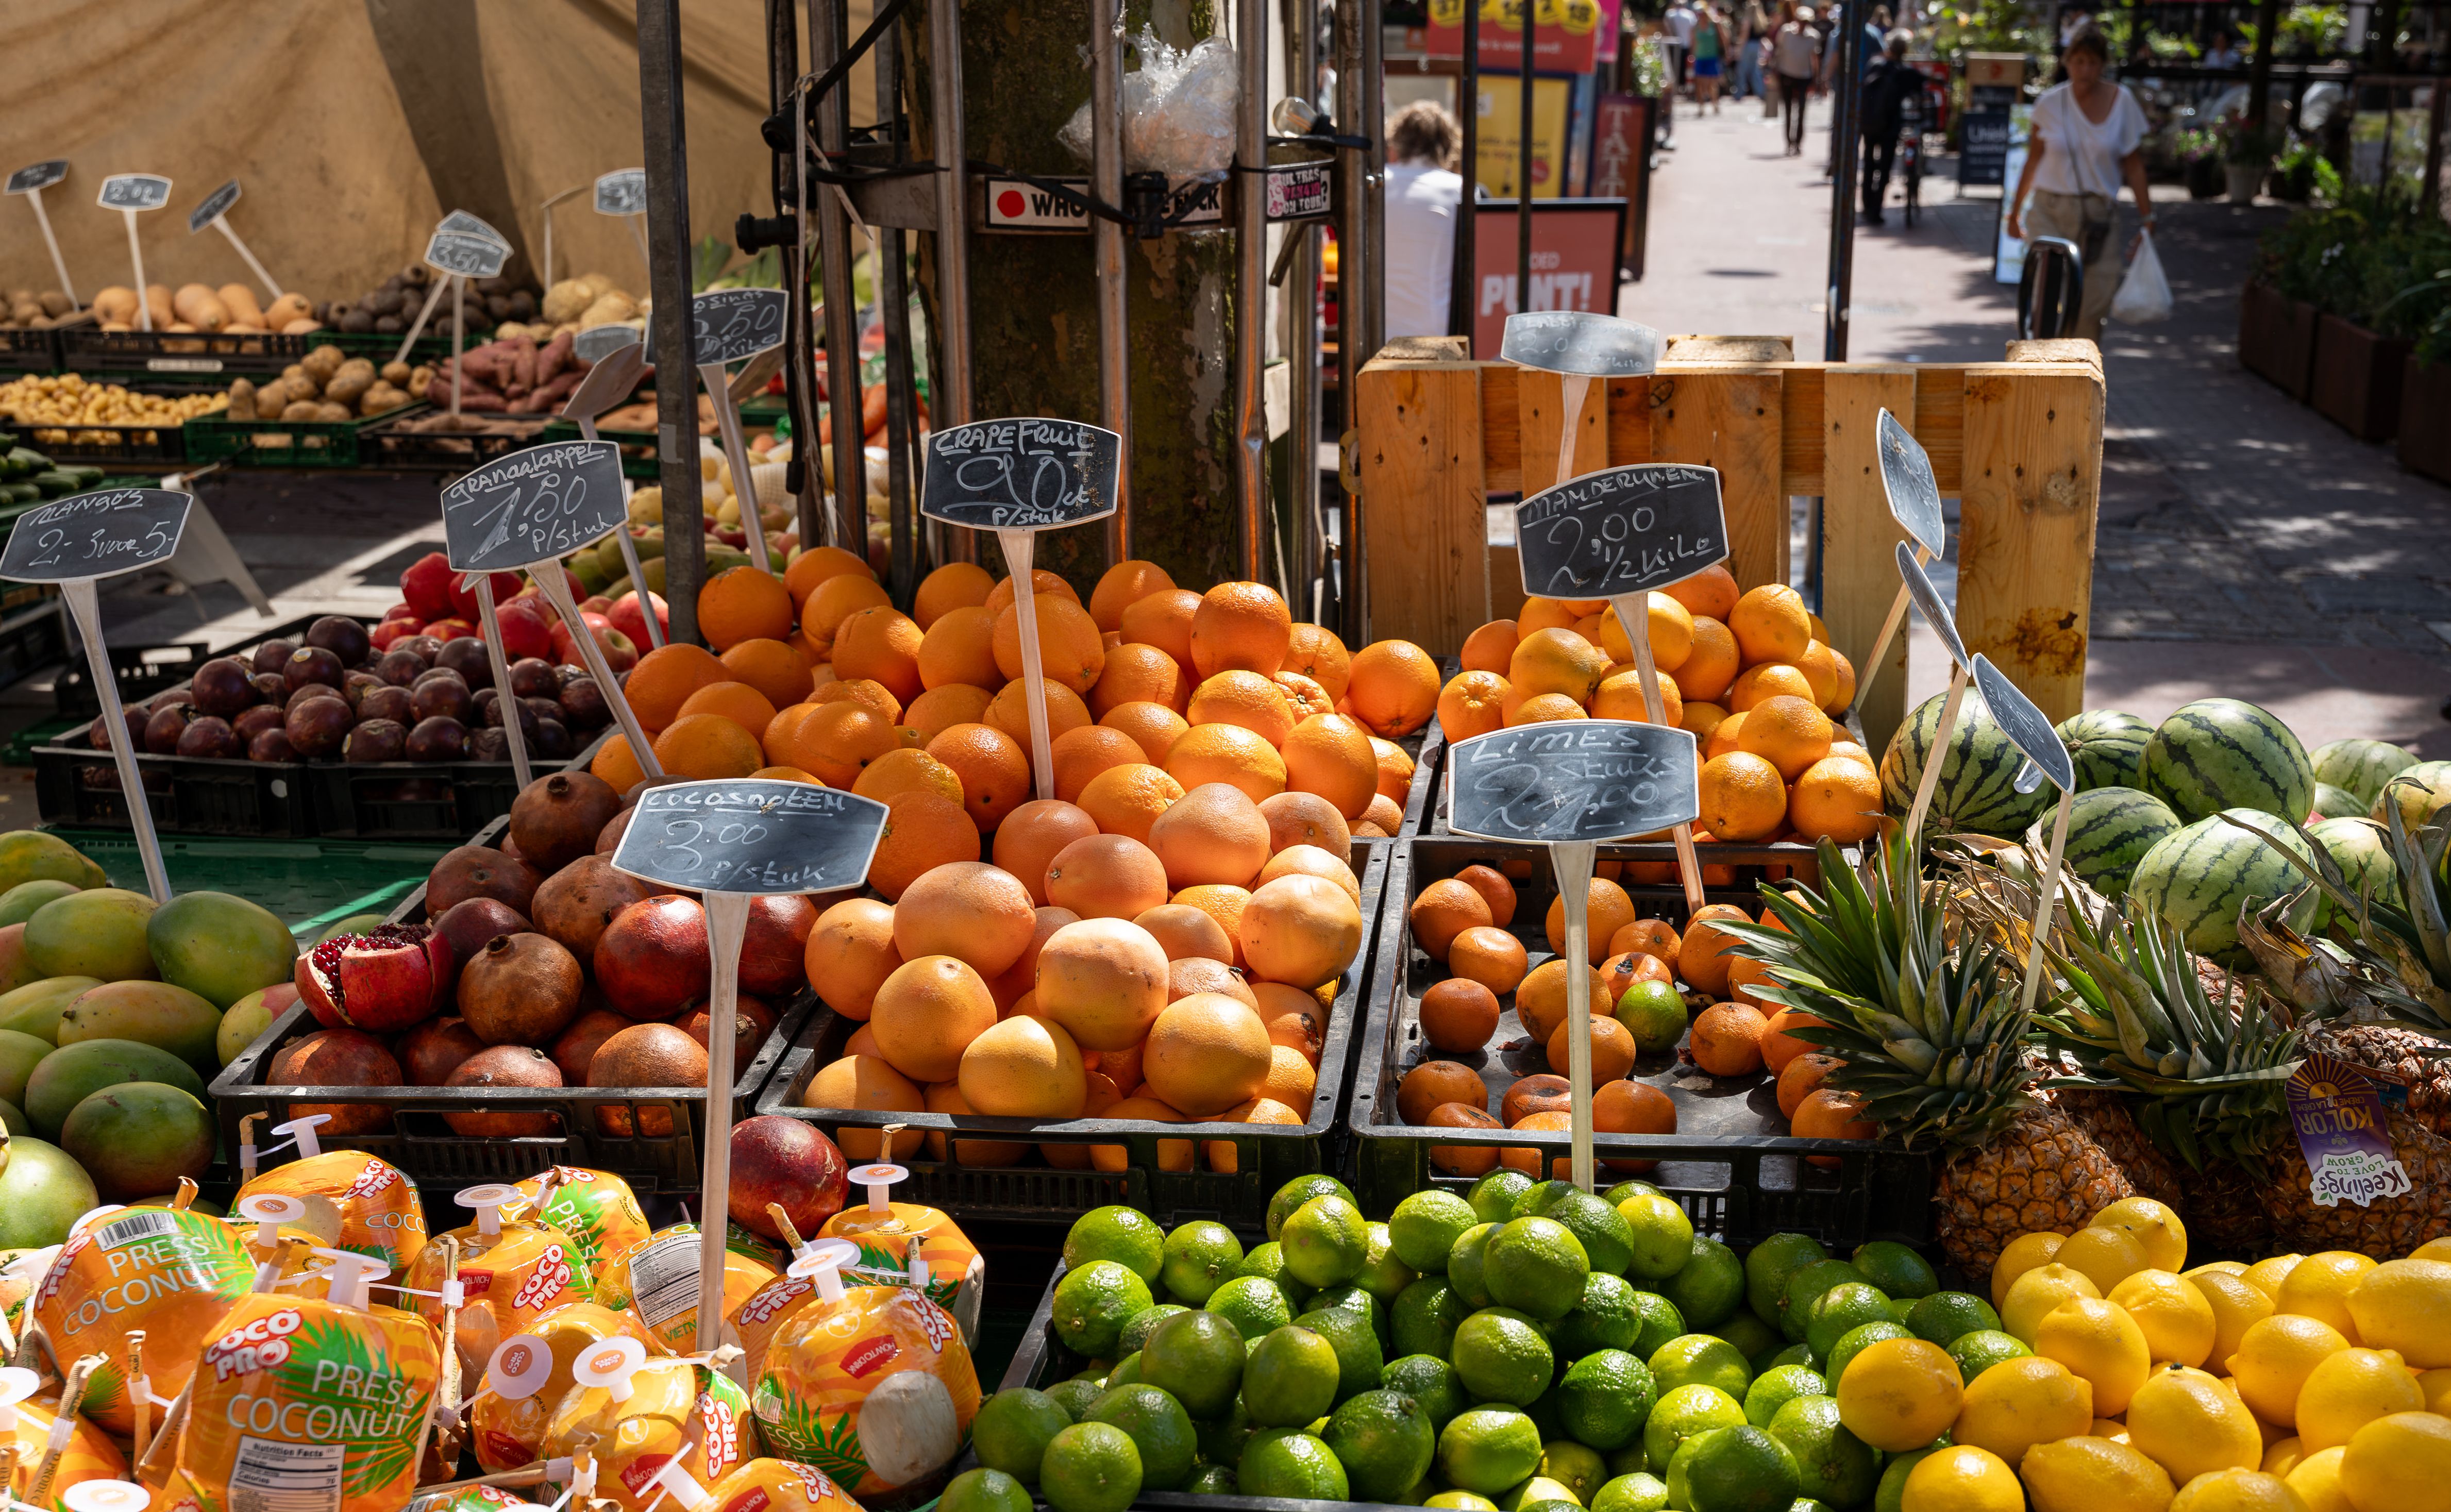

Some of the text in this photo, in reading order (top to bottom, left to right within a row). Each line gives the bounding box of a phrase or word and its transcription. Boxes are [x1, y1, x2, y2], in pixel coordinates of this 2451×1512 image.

[1299, 195, 1322, 211] TOUR
[343, 1158, 384, 1200] COCO
[2327, 1155, 2364, 1166] GROW
[2354, 1160, 2385, 1175] LOVE
[361, 1168, 398, 1199] PRO
[2319, 1166, 2406, 1202] Keelings
[106, 1235, 211, 1278] PRESS
[547, 1199, 600, 1278] PRESS
[512, 1245, 564, 1308] COCO
[531, 1262, 571, 1311] PRO
[63, 1261, 220, 1336] COCONUT
[755, 1282, 814, 1323] PRO
[206, 1307, 302, 1364] COCO
[901, 1287, 943, 1353] COCO
[214, 1336, 290, 1382] PRO
[507, 1352, 519, 1369] PRO
[511, 1351, 525, 1373] COCO
[312, 1359, 419, 1409] PRESS
[227, 1393, 412, 1439] COCONUT
[715, 1400, 737, 1464] PRO
[254, 1443, 324, 1457] Nutrition Facts
[766, 1425, 805, 1451] ESS
